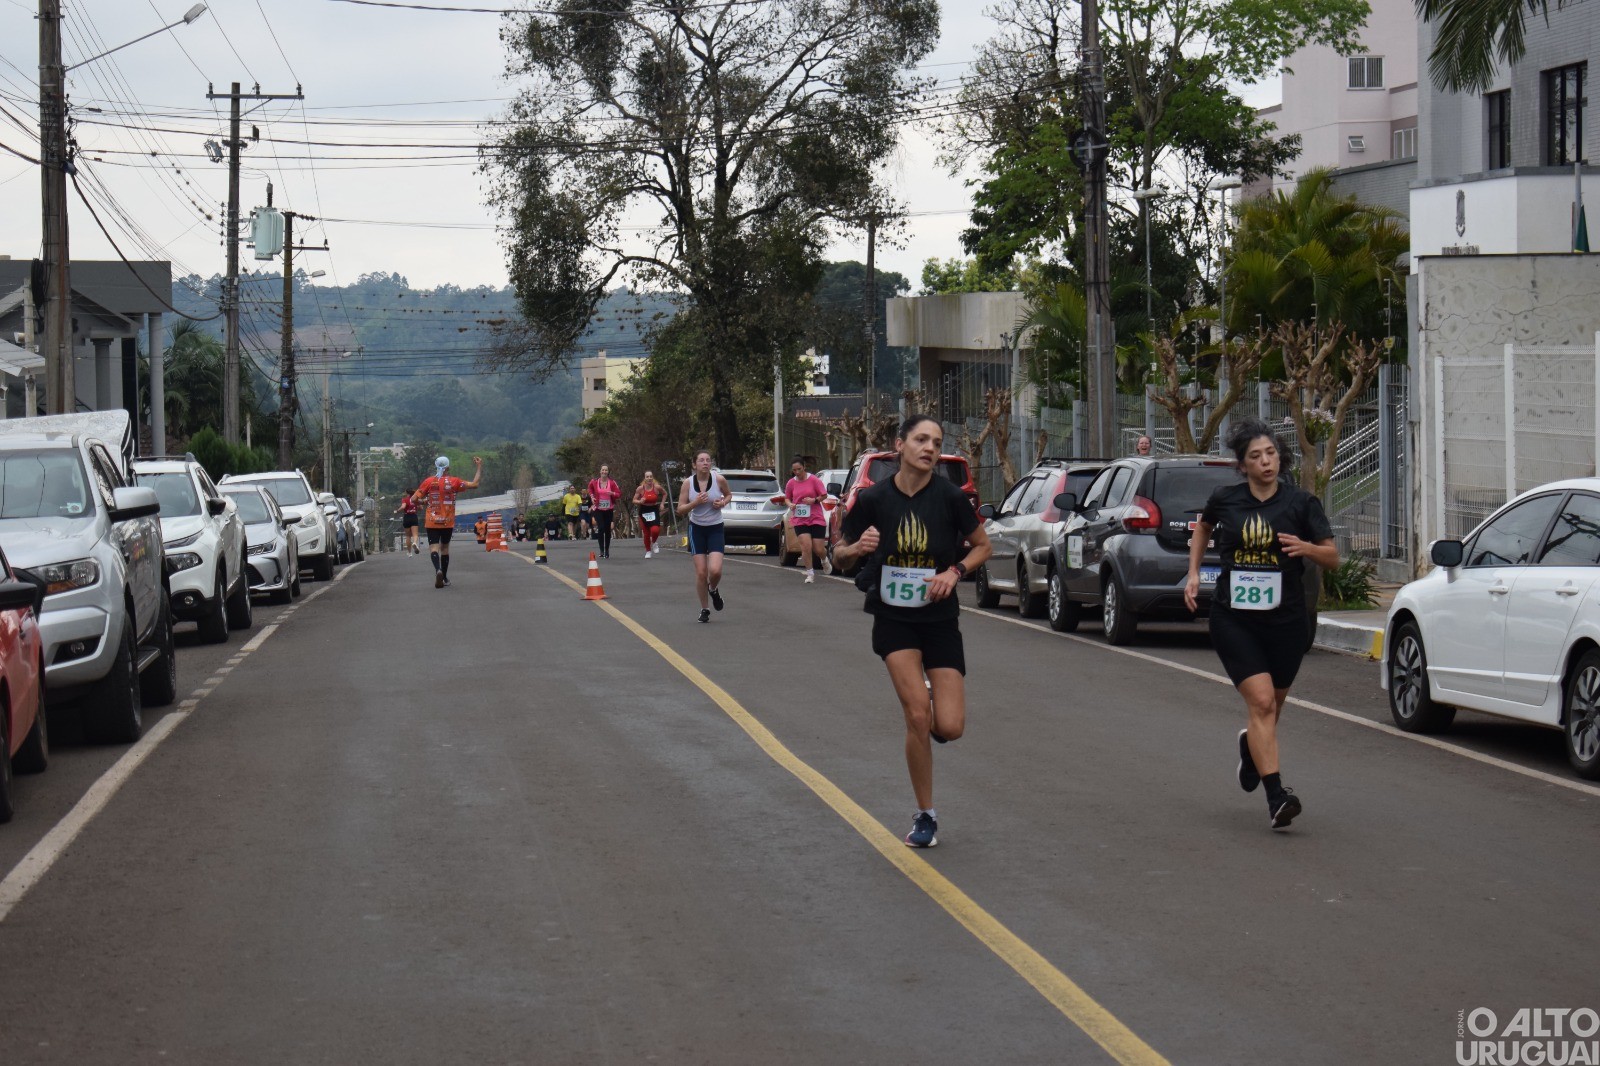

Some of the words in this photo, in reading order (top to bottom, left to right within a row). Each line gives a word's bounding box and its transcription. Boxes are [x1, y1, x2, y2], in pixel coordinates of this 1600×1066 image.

[797, 508, 806, 516] 39
[886, 582, 927, 601] 151
[1234, 586, 1273, 603] 281
